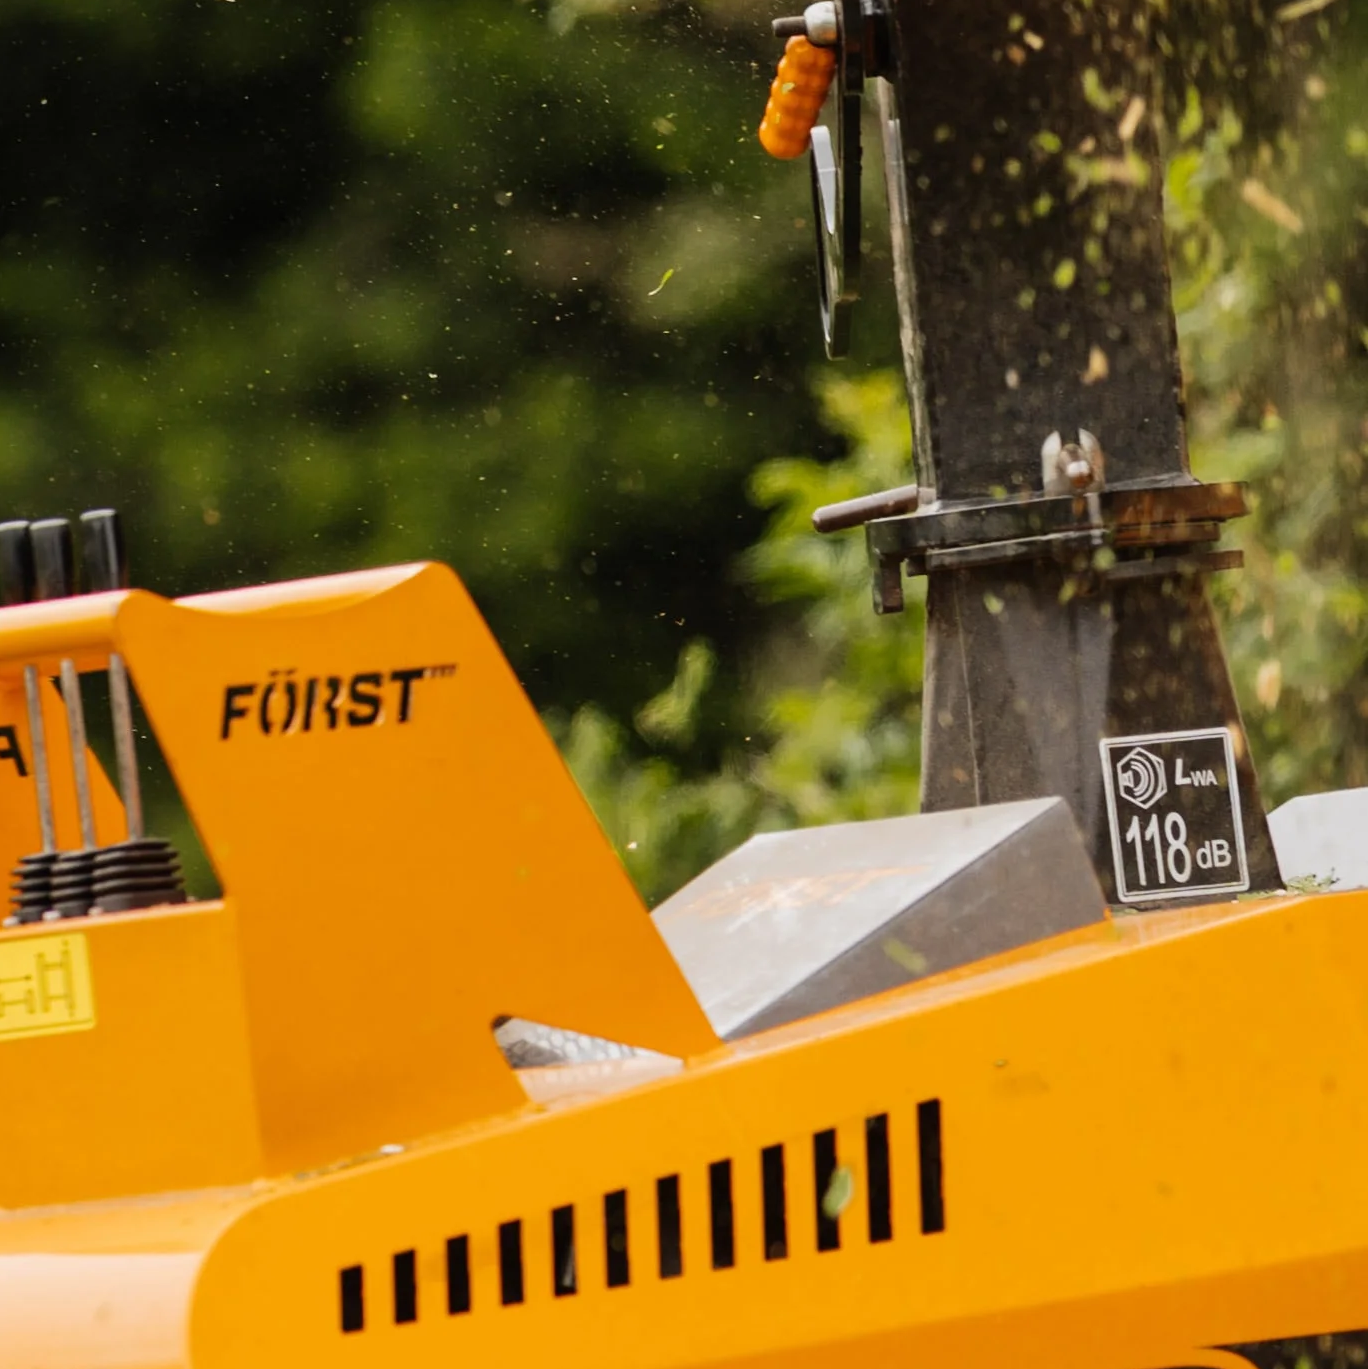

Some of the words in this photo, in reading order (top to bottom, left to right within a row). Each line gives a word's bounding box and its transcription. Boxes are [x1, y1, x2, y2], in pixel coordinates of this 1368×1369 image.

[219, 667, 427, 741] FÖRST
[1125, 811, 1193, 887] 118
[1196, 838, 1232, 870] dB
